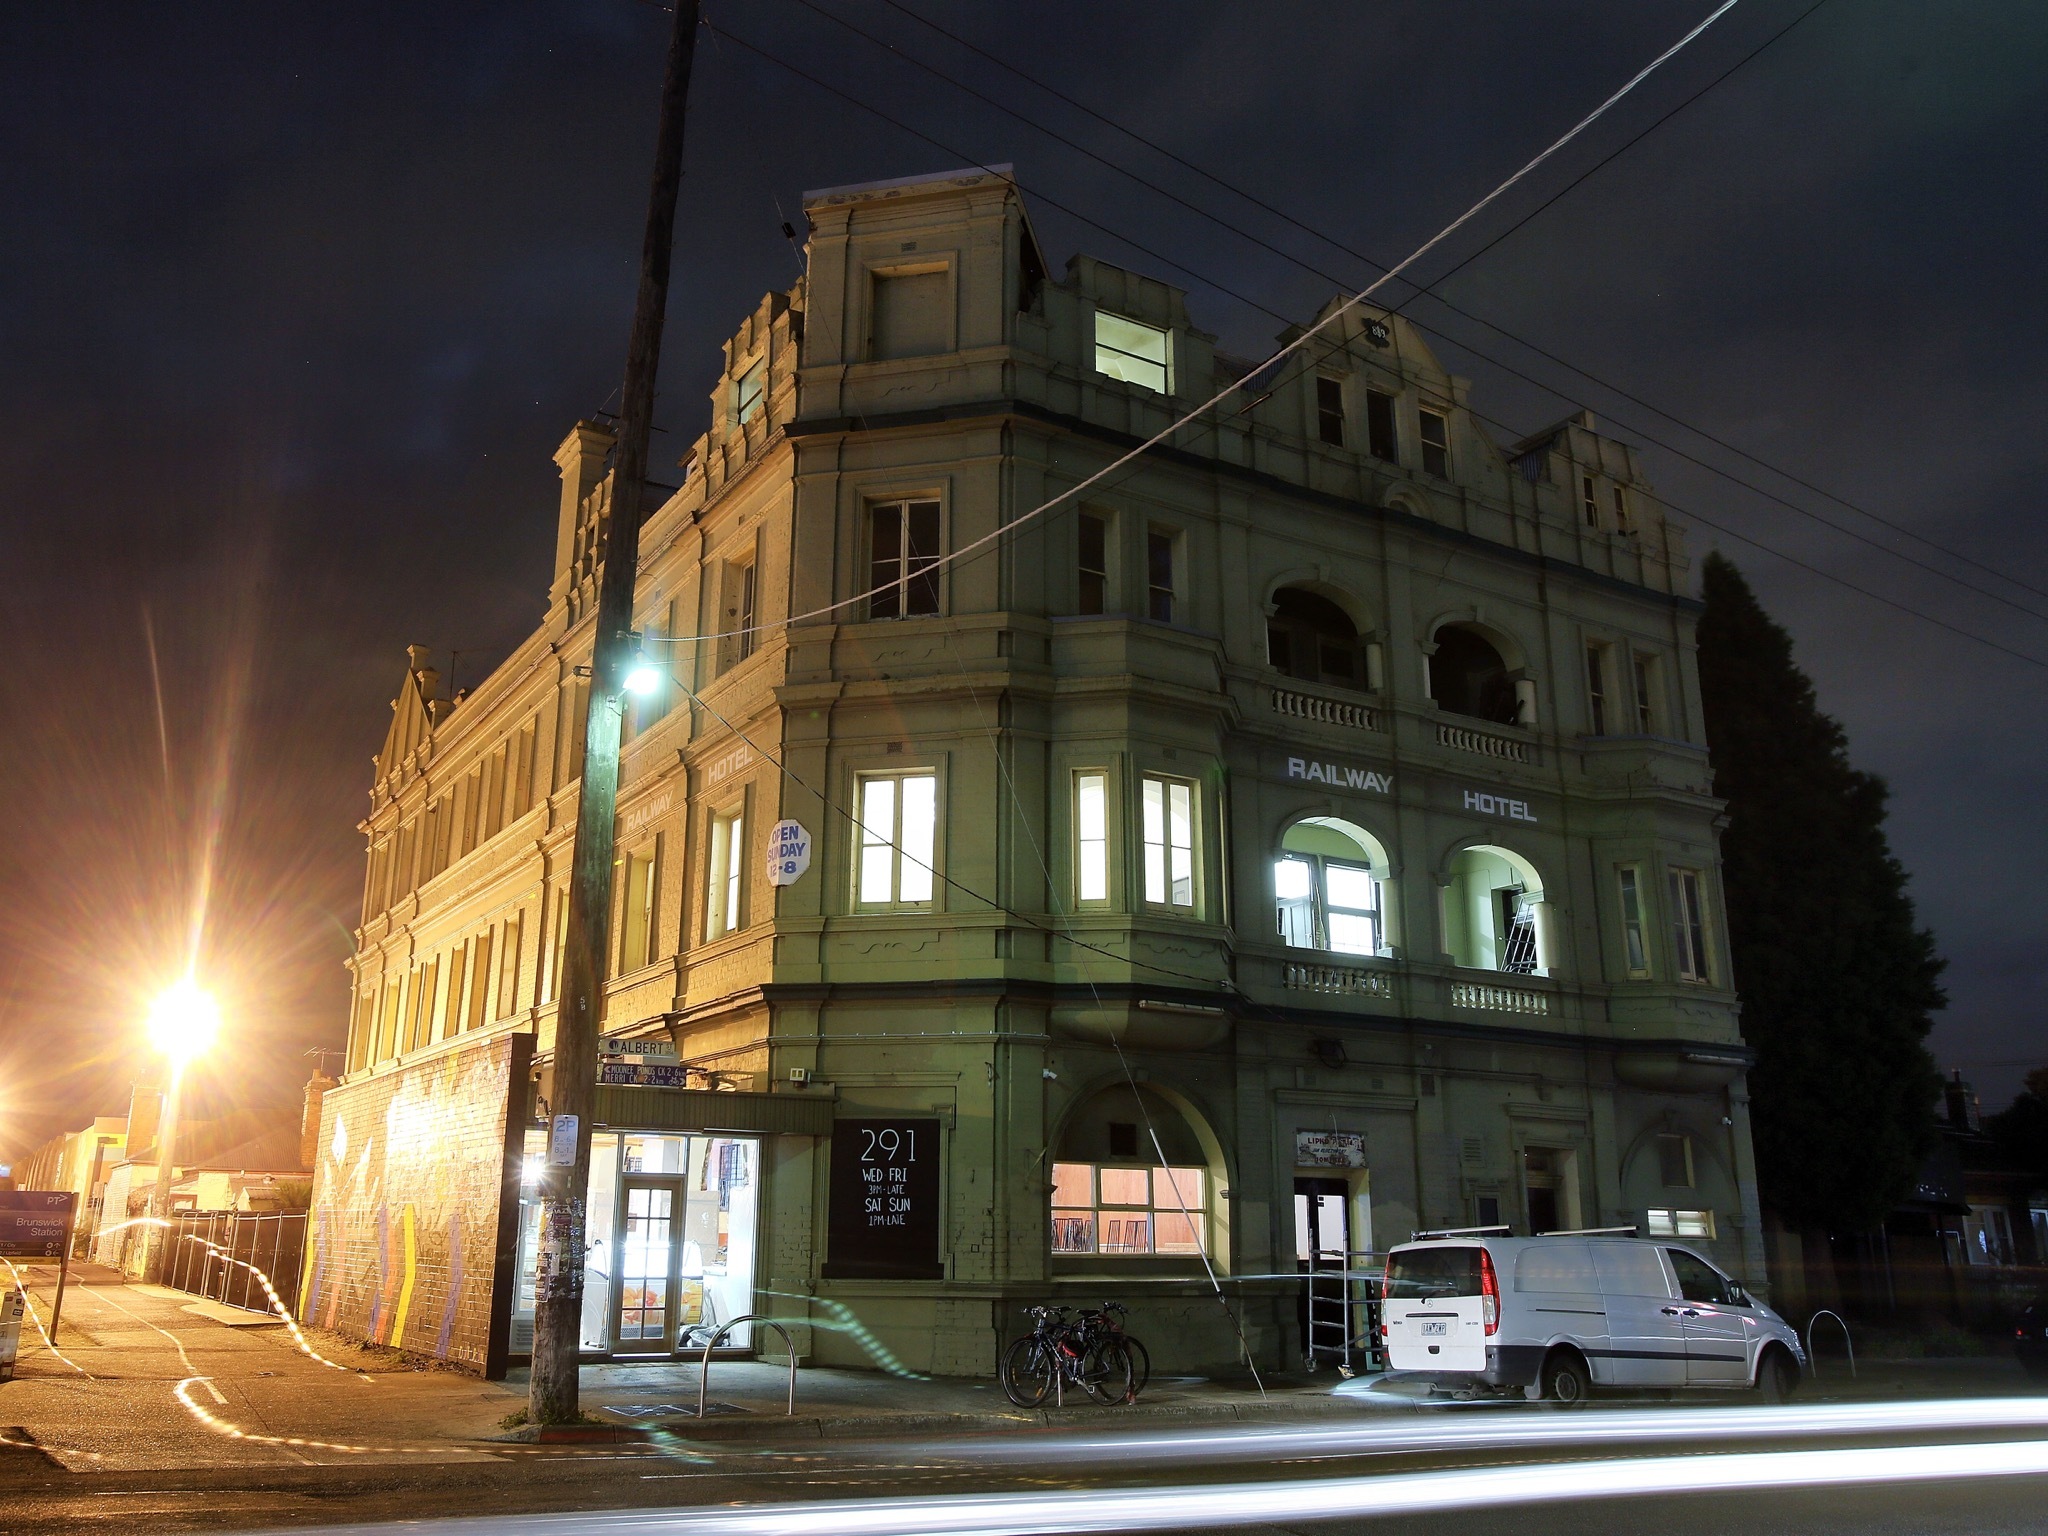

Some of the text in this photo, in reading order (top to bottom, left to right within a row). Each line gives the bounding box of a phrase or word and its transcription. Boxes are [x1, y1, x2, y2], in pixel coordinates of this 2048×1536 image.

[708, 745, 753, 785] HOTEL
[1288, 757, 1394, 794] RAILWAY
[626, 790, 673, 832] RAILWAY
[1464, 790, 1537, 822] HOTEL
[772, 826, 799, 844] OPEN
[768, 843, 806, 863] SUNDAY
[620, 1041, 664, 1054] ALBERT
[611, 1065, 634, 1075] MOONEE
[637, 1066, 655, 1076] PONDS
[658, 1067, 666, 1076] CK
[605, 1073, 626, 1083] MERRI
[629, 1075, 638, 1084] CK
[556, 1120, 575, 1132] 2P
[861, 1129, 916, 1162] 291
[862, 1168, 907, 1182] WED FRI
[865, 1197, 911, 1212] SAT SUN
[16, 1217, 64, 1227] Brunswick
[30, 1227, 63, 1237] Station
